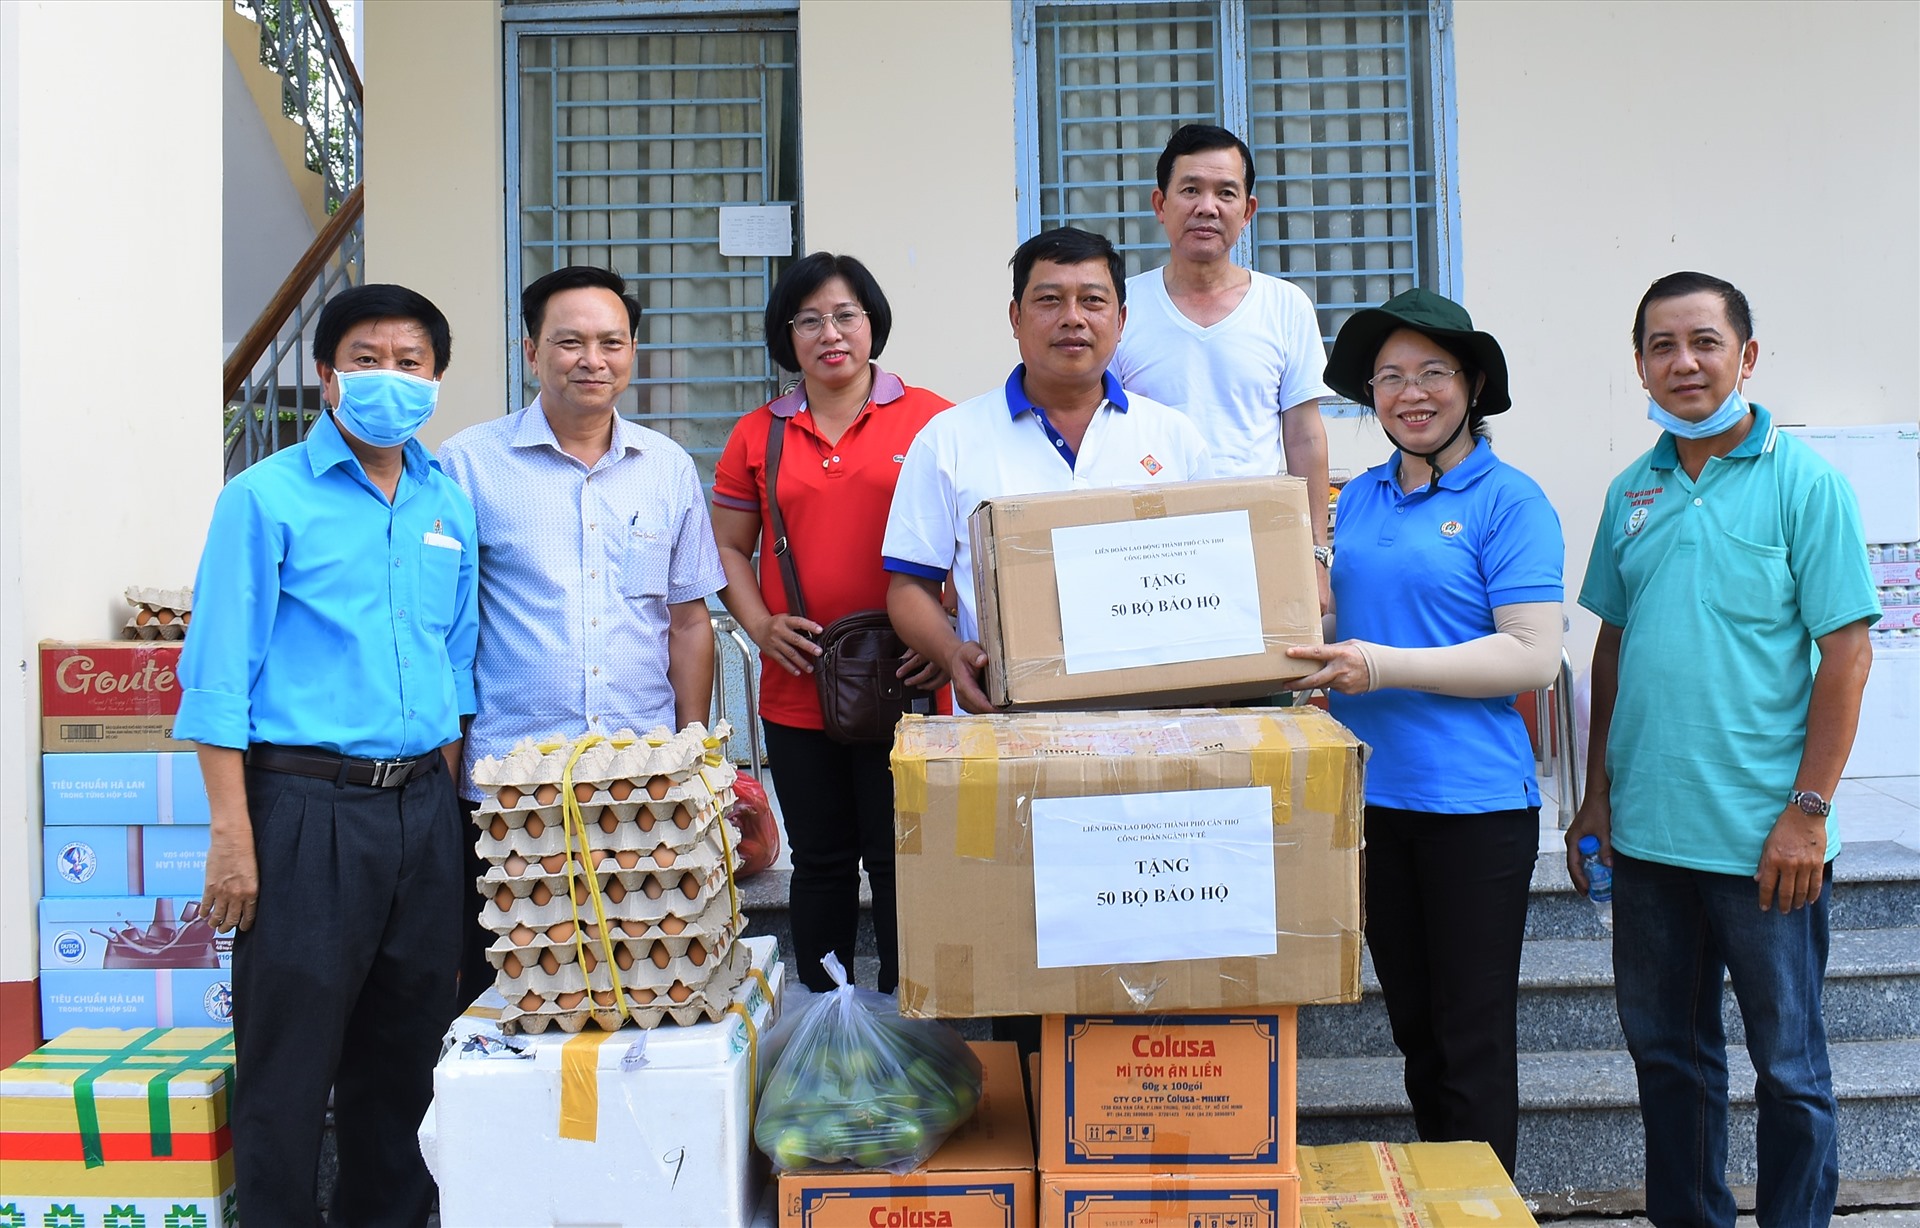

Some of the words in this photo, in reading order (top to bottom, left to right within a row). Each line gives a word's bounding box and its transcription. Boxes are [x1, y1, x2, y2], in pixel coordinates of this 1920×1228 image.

[1140, 572, 1187, 591] TẶNG
[1111, 603, 1127, 617] 50
[1131, 599, 1154, 617] BỘ
[1158, 595, 1192, 612] BẢO
[1197, 593, 1221, 610] HỘ
[56, 654, 176, 695] Gouté
[51, 779, 73, 790] TIÊU
[74, 777, 108, 790] CHUẨN
[110, 779, 124, 790] HÀ
[126, 781, 145, 790] LAN
[60, 791, 84, 799] TRONG
[86, 790, 104, 799] TỪNG
[106, 791, 122, 800] HỘP
[123, 791, 138, 799] SỮA
[1082, 824, 1100, 832] LIÊN
[1101, 823, 1123, 832] ĐOÀN
[1124, 823, 1140, 831] LAO
[1141, 822, 1162, 831] ĐỘNG
[1163, 820, 1189, 829] THÀNH
[1190, 819, 1206, 827] PHỐ
[1206, 818, 1222, 826] CẦN
[1223, 818, 1240, 826] THƠ
[1117, 834, 1139, 843] CÔNG
[1140, 833, 1161, 841] ĐOÀN
[1161, 832, 1188, 840] NGÀNH
[1196, 830, 1206, 839] TẾ
[1135, 857, 1190, 878] TẶNG
[1097, 891, 1116, 906] 50
[1122, 887, 1148, 908] BỘ
[1154, 883, 1195, 903] BẢO
[1201, 882, 1229, 903] HỘ
[49, 993, 72, 1004] TIÊU
[74, 991, 107, 1004] CHUẨN
[109, 992, 124, 1004] HÀ
[126, 995, 145, 1004] LAN
[84, 1005, 104, 1013] TỪNG
[105, 1005, 121, 1014] HỘP
[122, 1005, 137, 1013] SỮA
[1132, 1034, 1216, 1058] Colusa
[1117, 1062, 1131, 1077] MÌ
[1135, 1063, 1164, 1077] TÔM
[1168, 1063, 1188, 1078] ĂN
[1192, 1060, 1222, 1077] LIỀN
[1142, 1082, 1160, 1092] 60g
[1171, 1081, 1203, 1092] 100gói
[1167, 1094, 1195, 1103] Colusa
[1201, 1095, 1230, 1103] MILIKET
[663, 1146, 685, 1191] 9
[869, 1206, 953, 1228] Colusa
